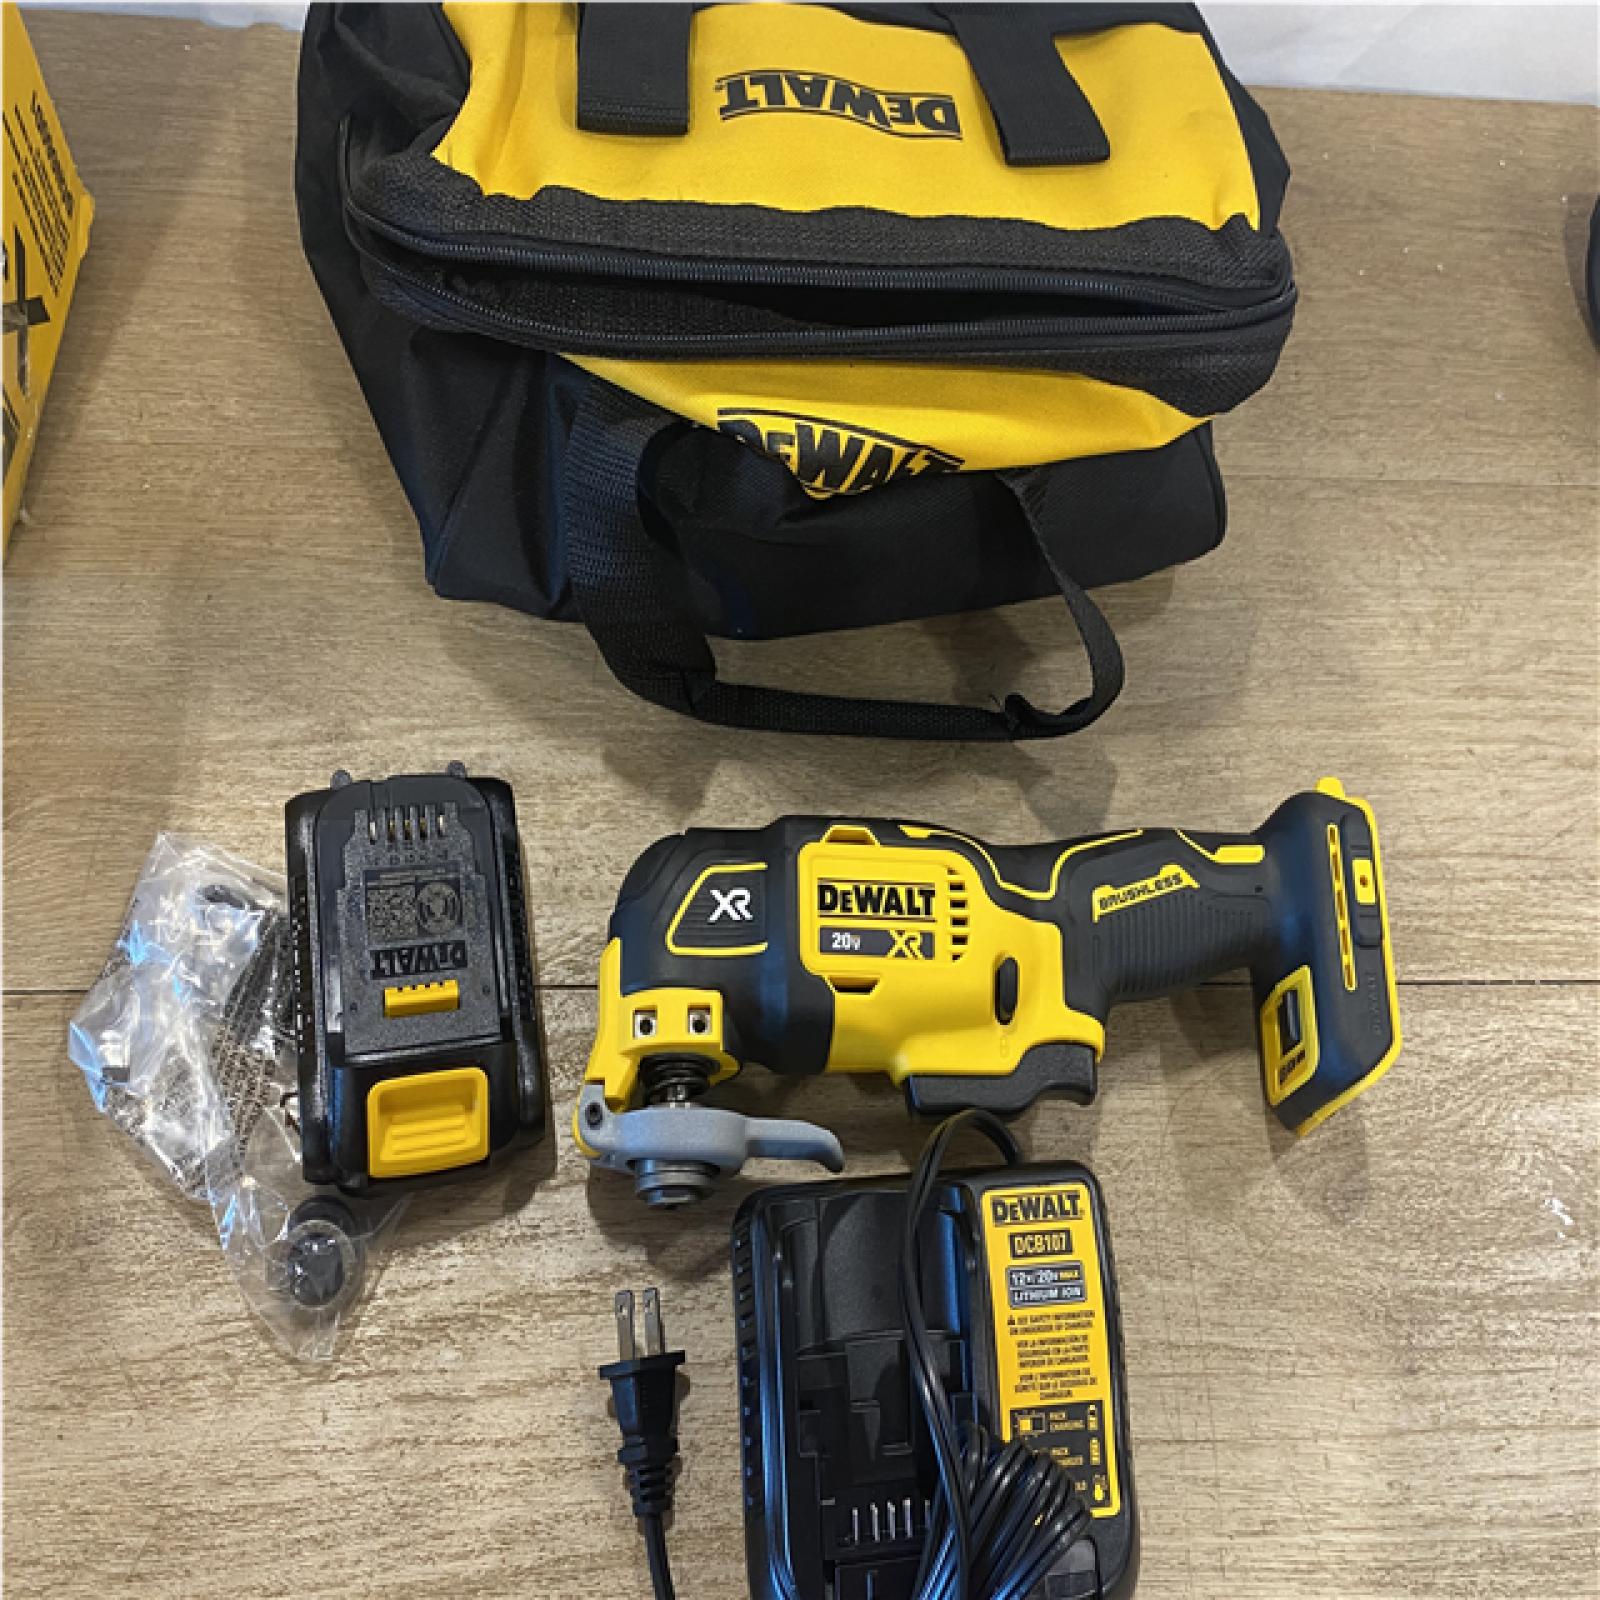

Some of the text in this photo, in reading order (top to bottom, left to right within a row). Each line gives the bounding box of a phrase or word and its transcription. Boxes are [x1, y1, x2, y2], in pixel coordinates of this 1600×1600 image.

[708, 888, 754, 925] XR
[818, 884, 936, 918] DEWALT
[886, 928, 925, 960] XR
[991, 1192, 1083, 1224] DEWALT
